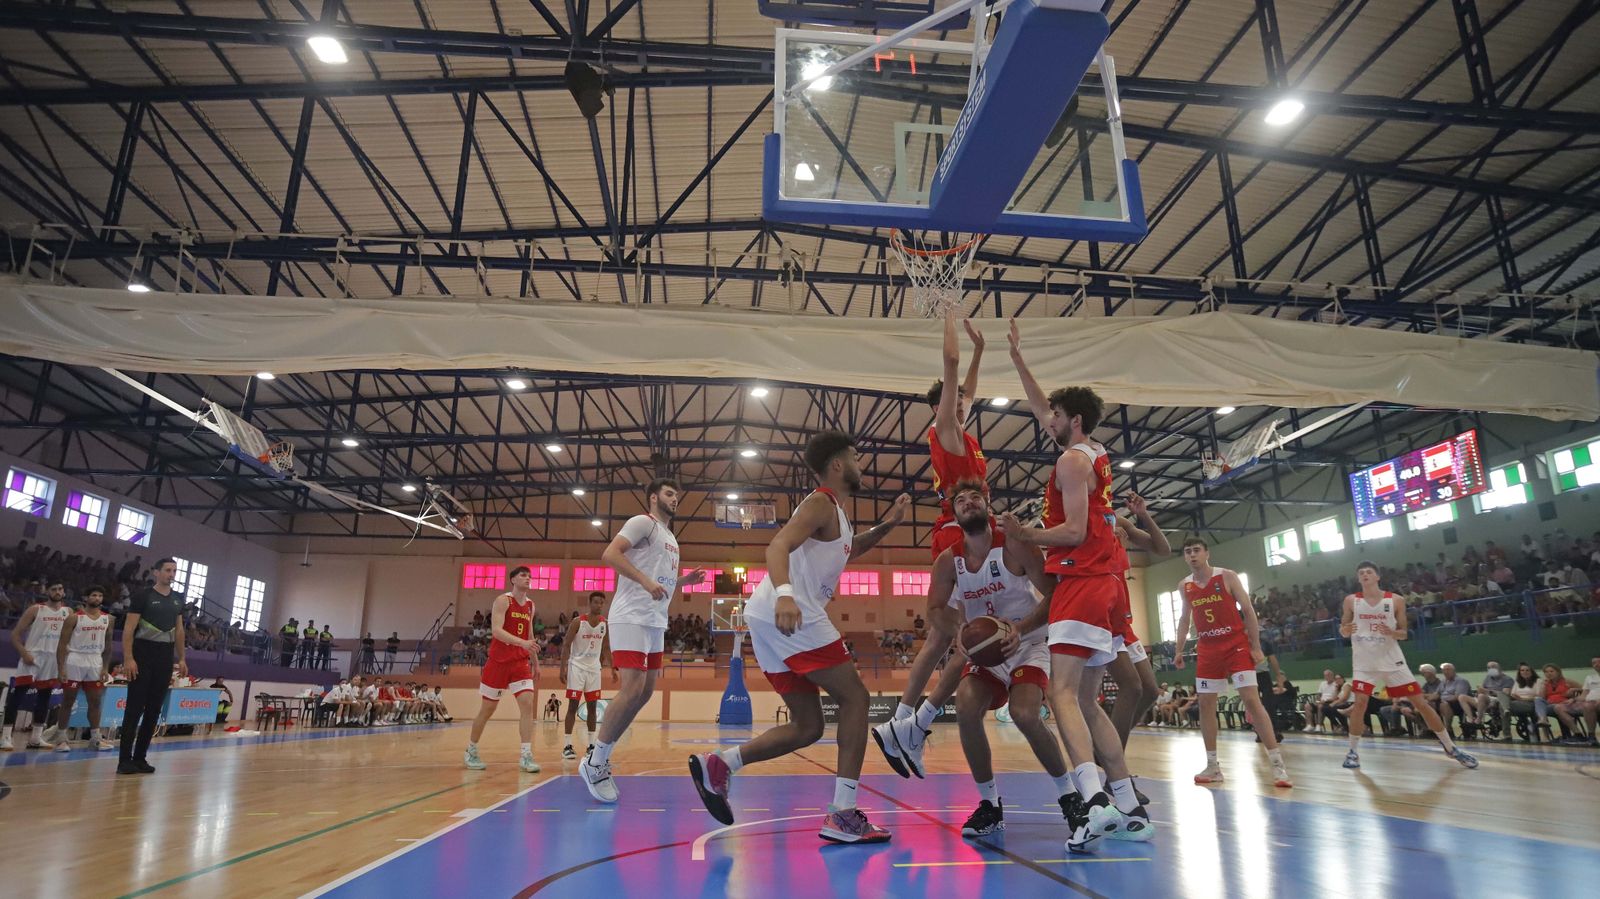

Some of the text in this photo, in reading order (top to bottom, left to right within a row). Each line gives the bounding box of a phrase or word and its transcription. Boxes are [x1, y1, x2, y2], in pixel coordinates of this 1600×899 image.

[736, 573, 747, 583] 14
[964, 581, 1006, 600] ESPAÑA
[1192, 594, 1223, 607] ESPAÑA
[985, 601, 995, 616] 8
[1204, 609, 1215, 623] 5
[517, 623, 524, 635] 9
[590, 641, 595, 649] 5
